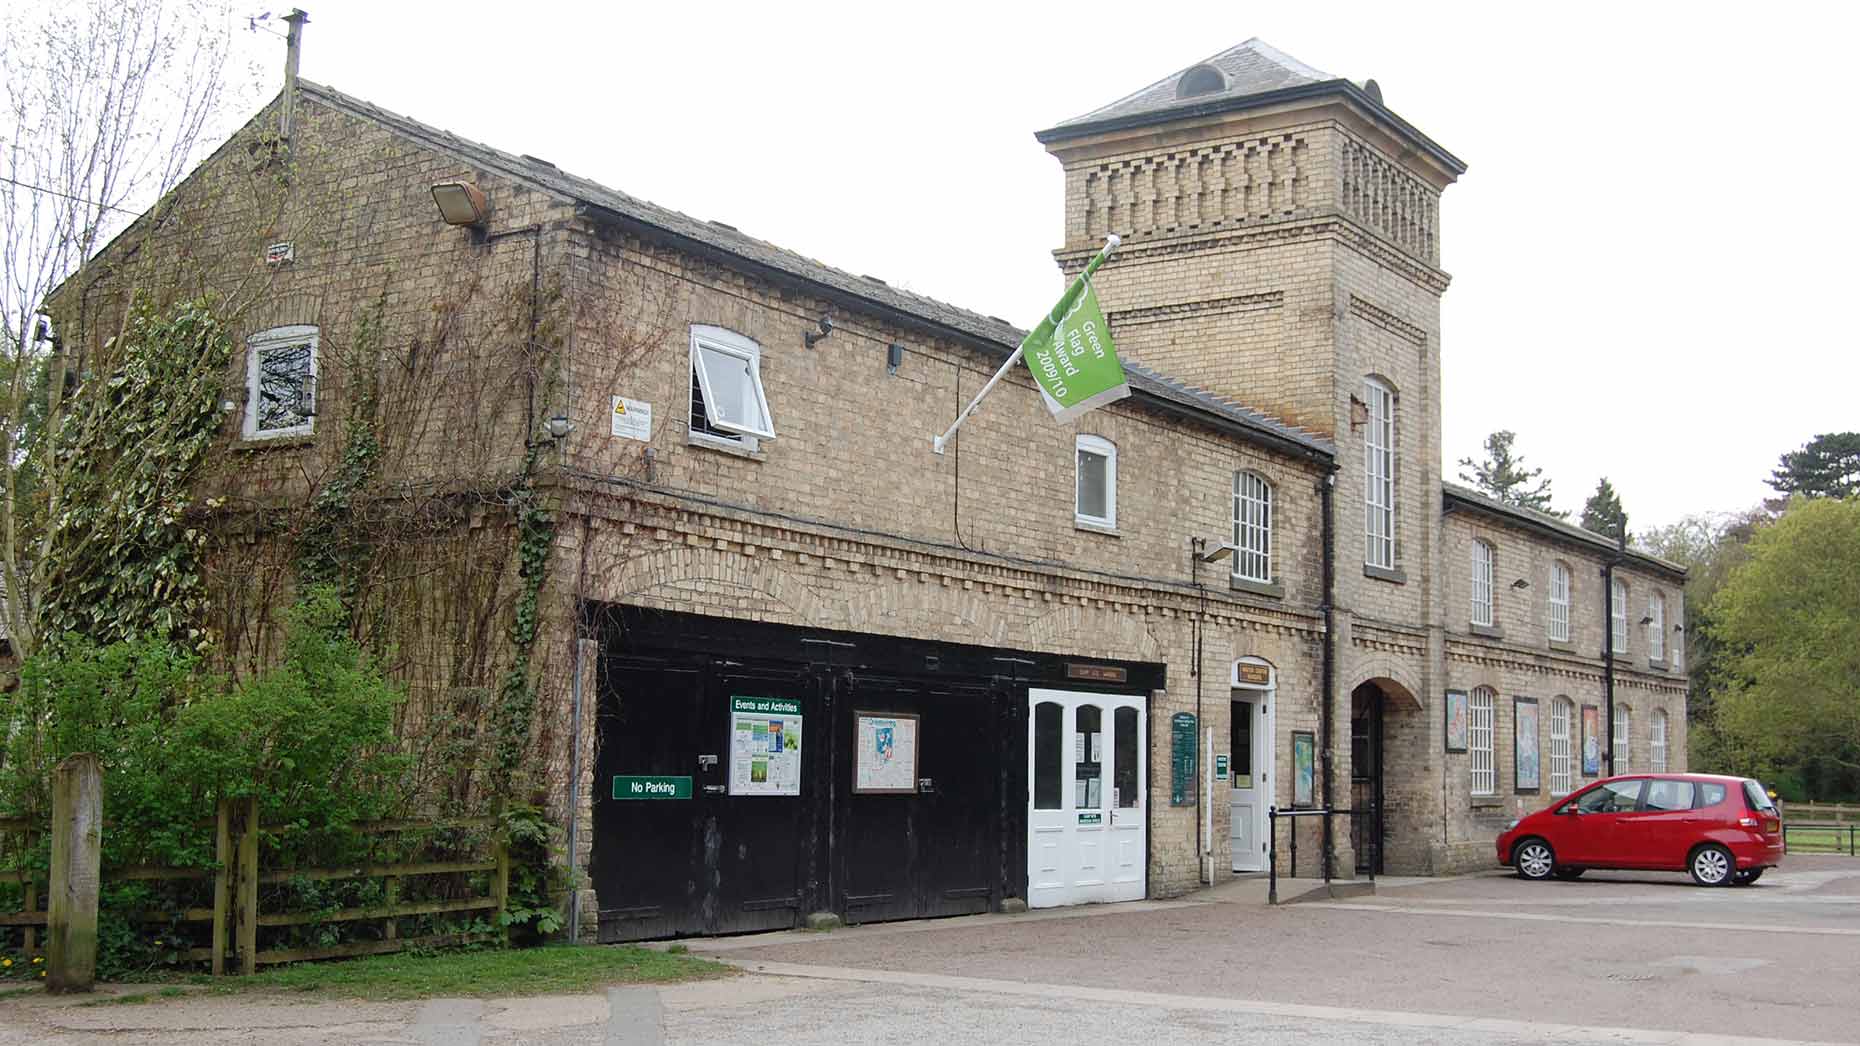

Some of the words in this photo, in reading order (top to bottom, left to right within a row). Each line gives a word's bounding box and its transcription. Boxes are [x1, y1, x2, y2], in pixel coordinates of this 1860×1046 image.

[1067, 328, 1085, 356] Flag
[1083, 321, 1105, 358] Green
[1036, 350, 1068, 398] 2009/10
[1053, 341, 1080, 376] Award
[735, 699, 756, 710] Events
[757, 702, 770, 711] and
[770, 701, 798, 713] Activities
[631, 781, 643, 793] No
[645, 781, 675, 796] Parking
